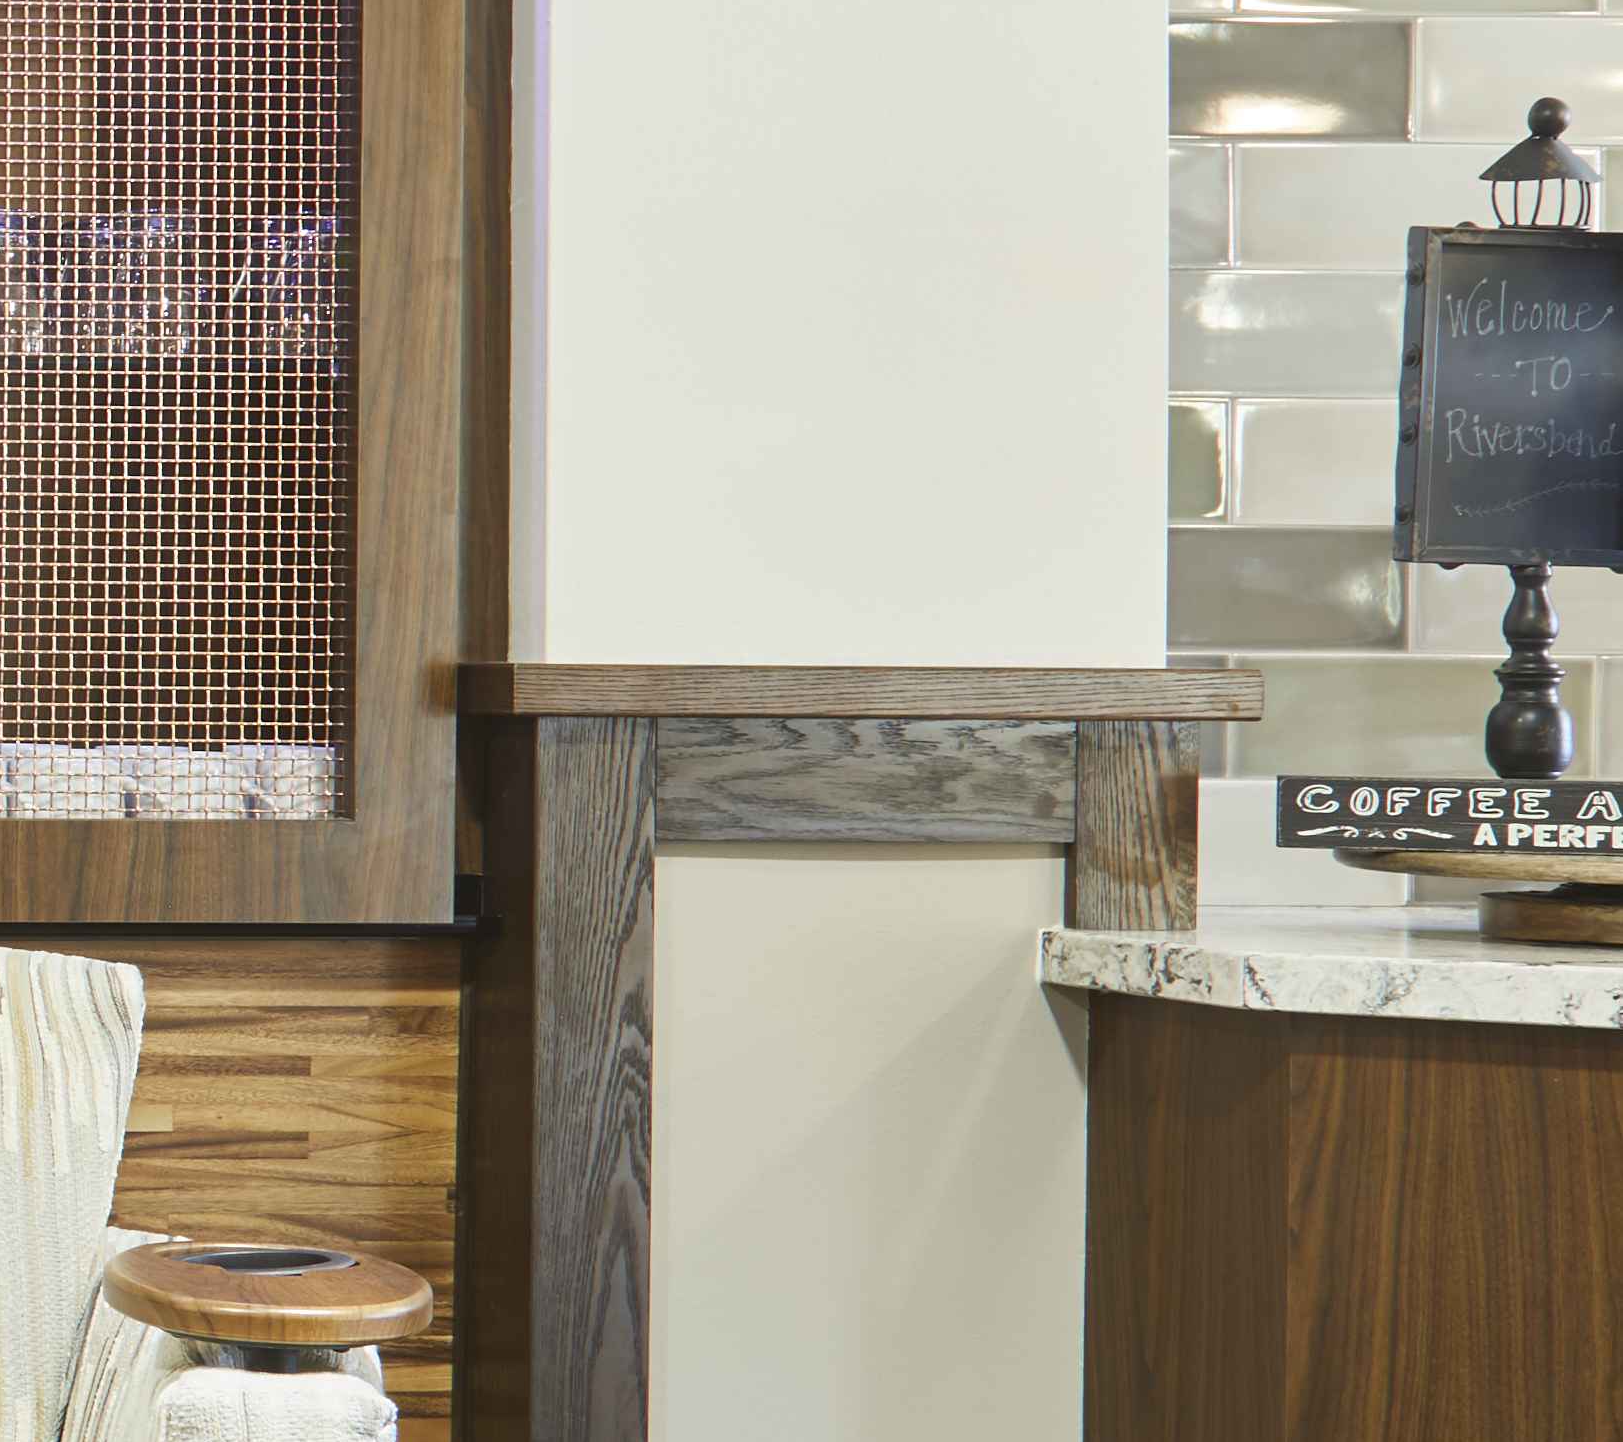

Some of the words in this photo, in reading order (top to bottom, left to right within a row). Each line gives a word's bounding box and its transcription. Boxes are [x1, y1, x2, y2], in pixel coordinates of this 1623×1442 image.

[1445, 278, 1614, 337] Welcome
[1515, 357, 1572, 397] TO
[1445, 408, 1623, 462] Riversbend
[1296, 784, 1552, 820] COFFEE
[1473, 823, 1498, 846] A
